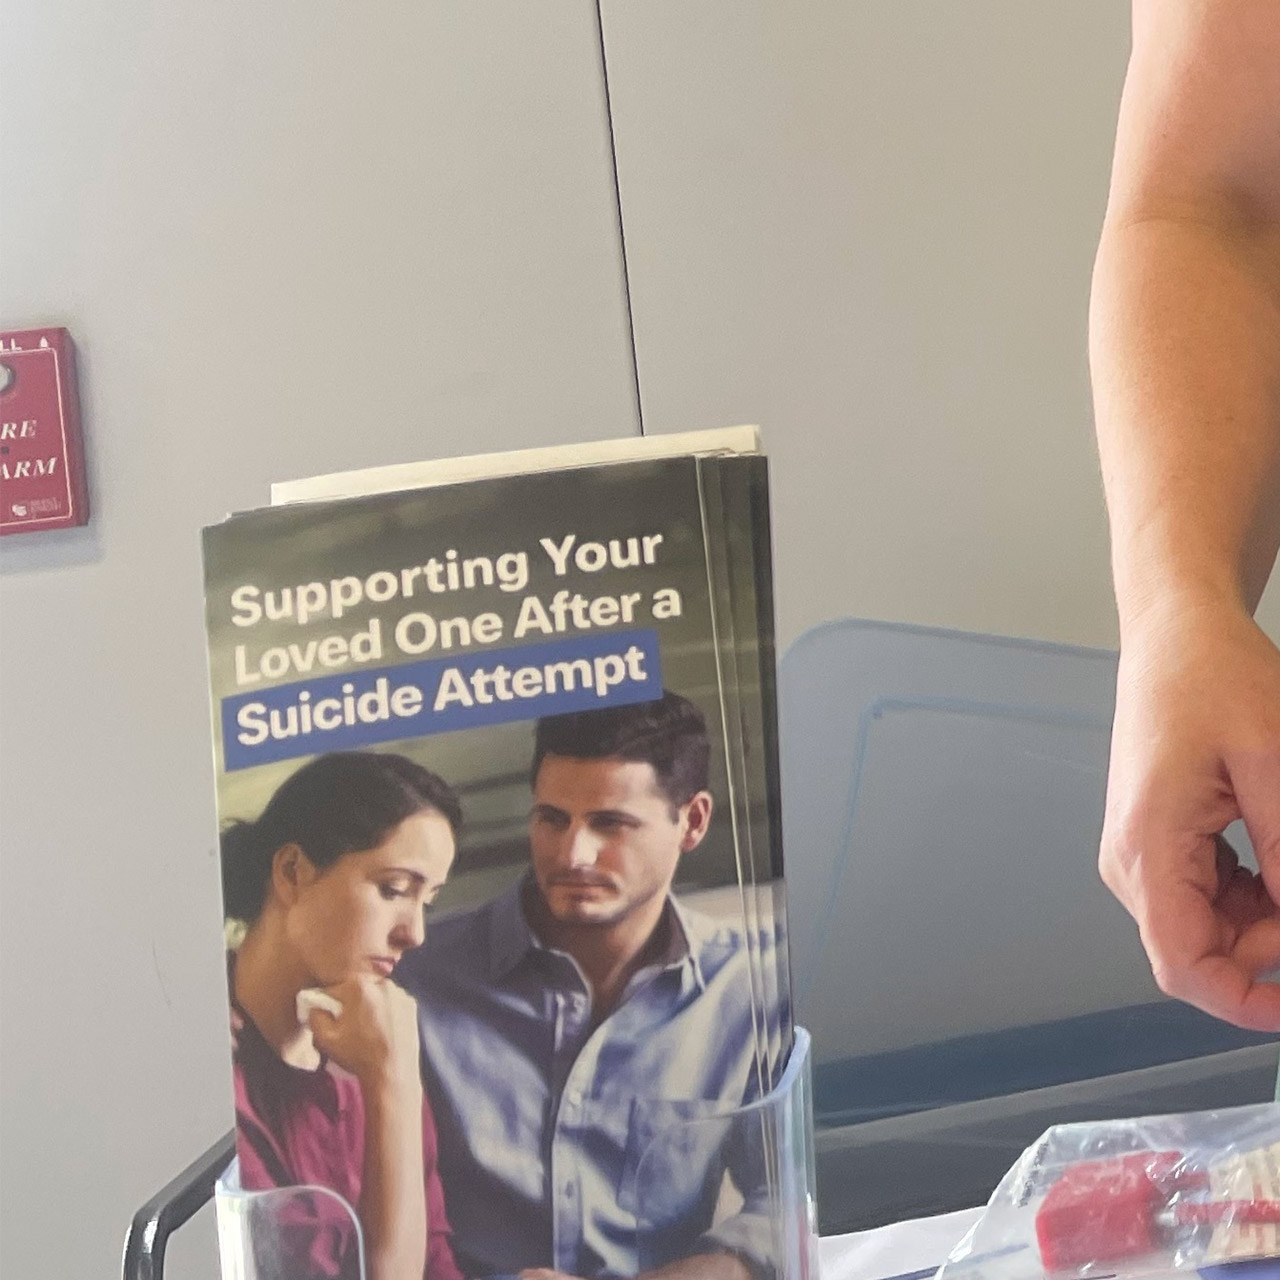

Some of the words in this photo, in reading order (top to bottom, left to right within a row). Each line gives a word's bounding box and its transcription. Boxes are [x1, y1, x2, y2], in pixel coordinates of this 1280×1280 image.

[230, 549, 530, 628] Supporting
[540, 532, 664, 576] Your
[234, 618, 383, 686] Loved
[394, 604, 504, 655] One
[513, 590, 641, 638] After
[651, 586, 683, 620] a
[235, 677, 424, 747] Suicide
[433, 644, 648, 712] Attempt
